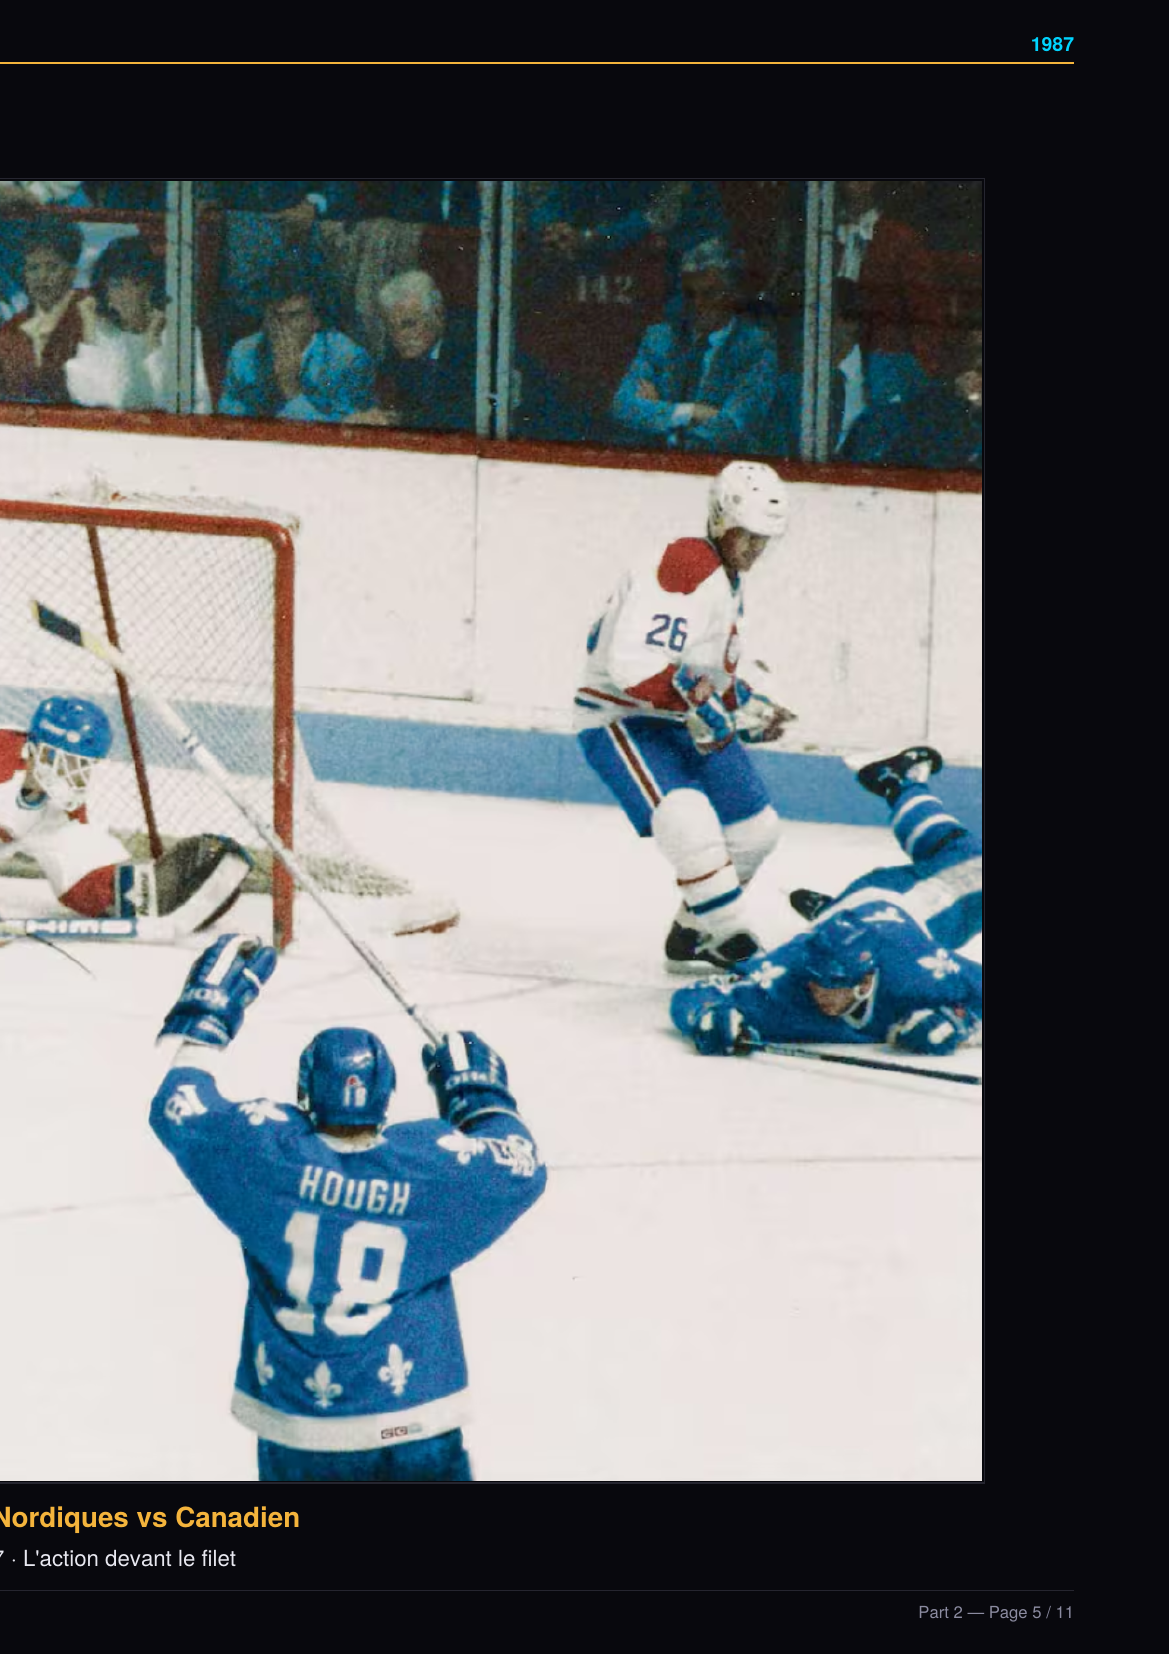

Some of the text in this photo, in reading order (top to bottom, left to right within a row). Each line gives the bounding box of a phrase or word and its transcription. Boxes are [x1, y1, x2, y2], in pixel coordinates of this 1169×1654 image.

[577, 275, 633, 304] 142
[645, 613, 688, 652] 26
[299, 1164, 411, 1217] HOUGH
[274, 1210, 408, 1337] 18
